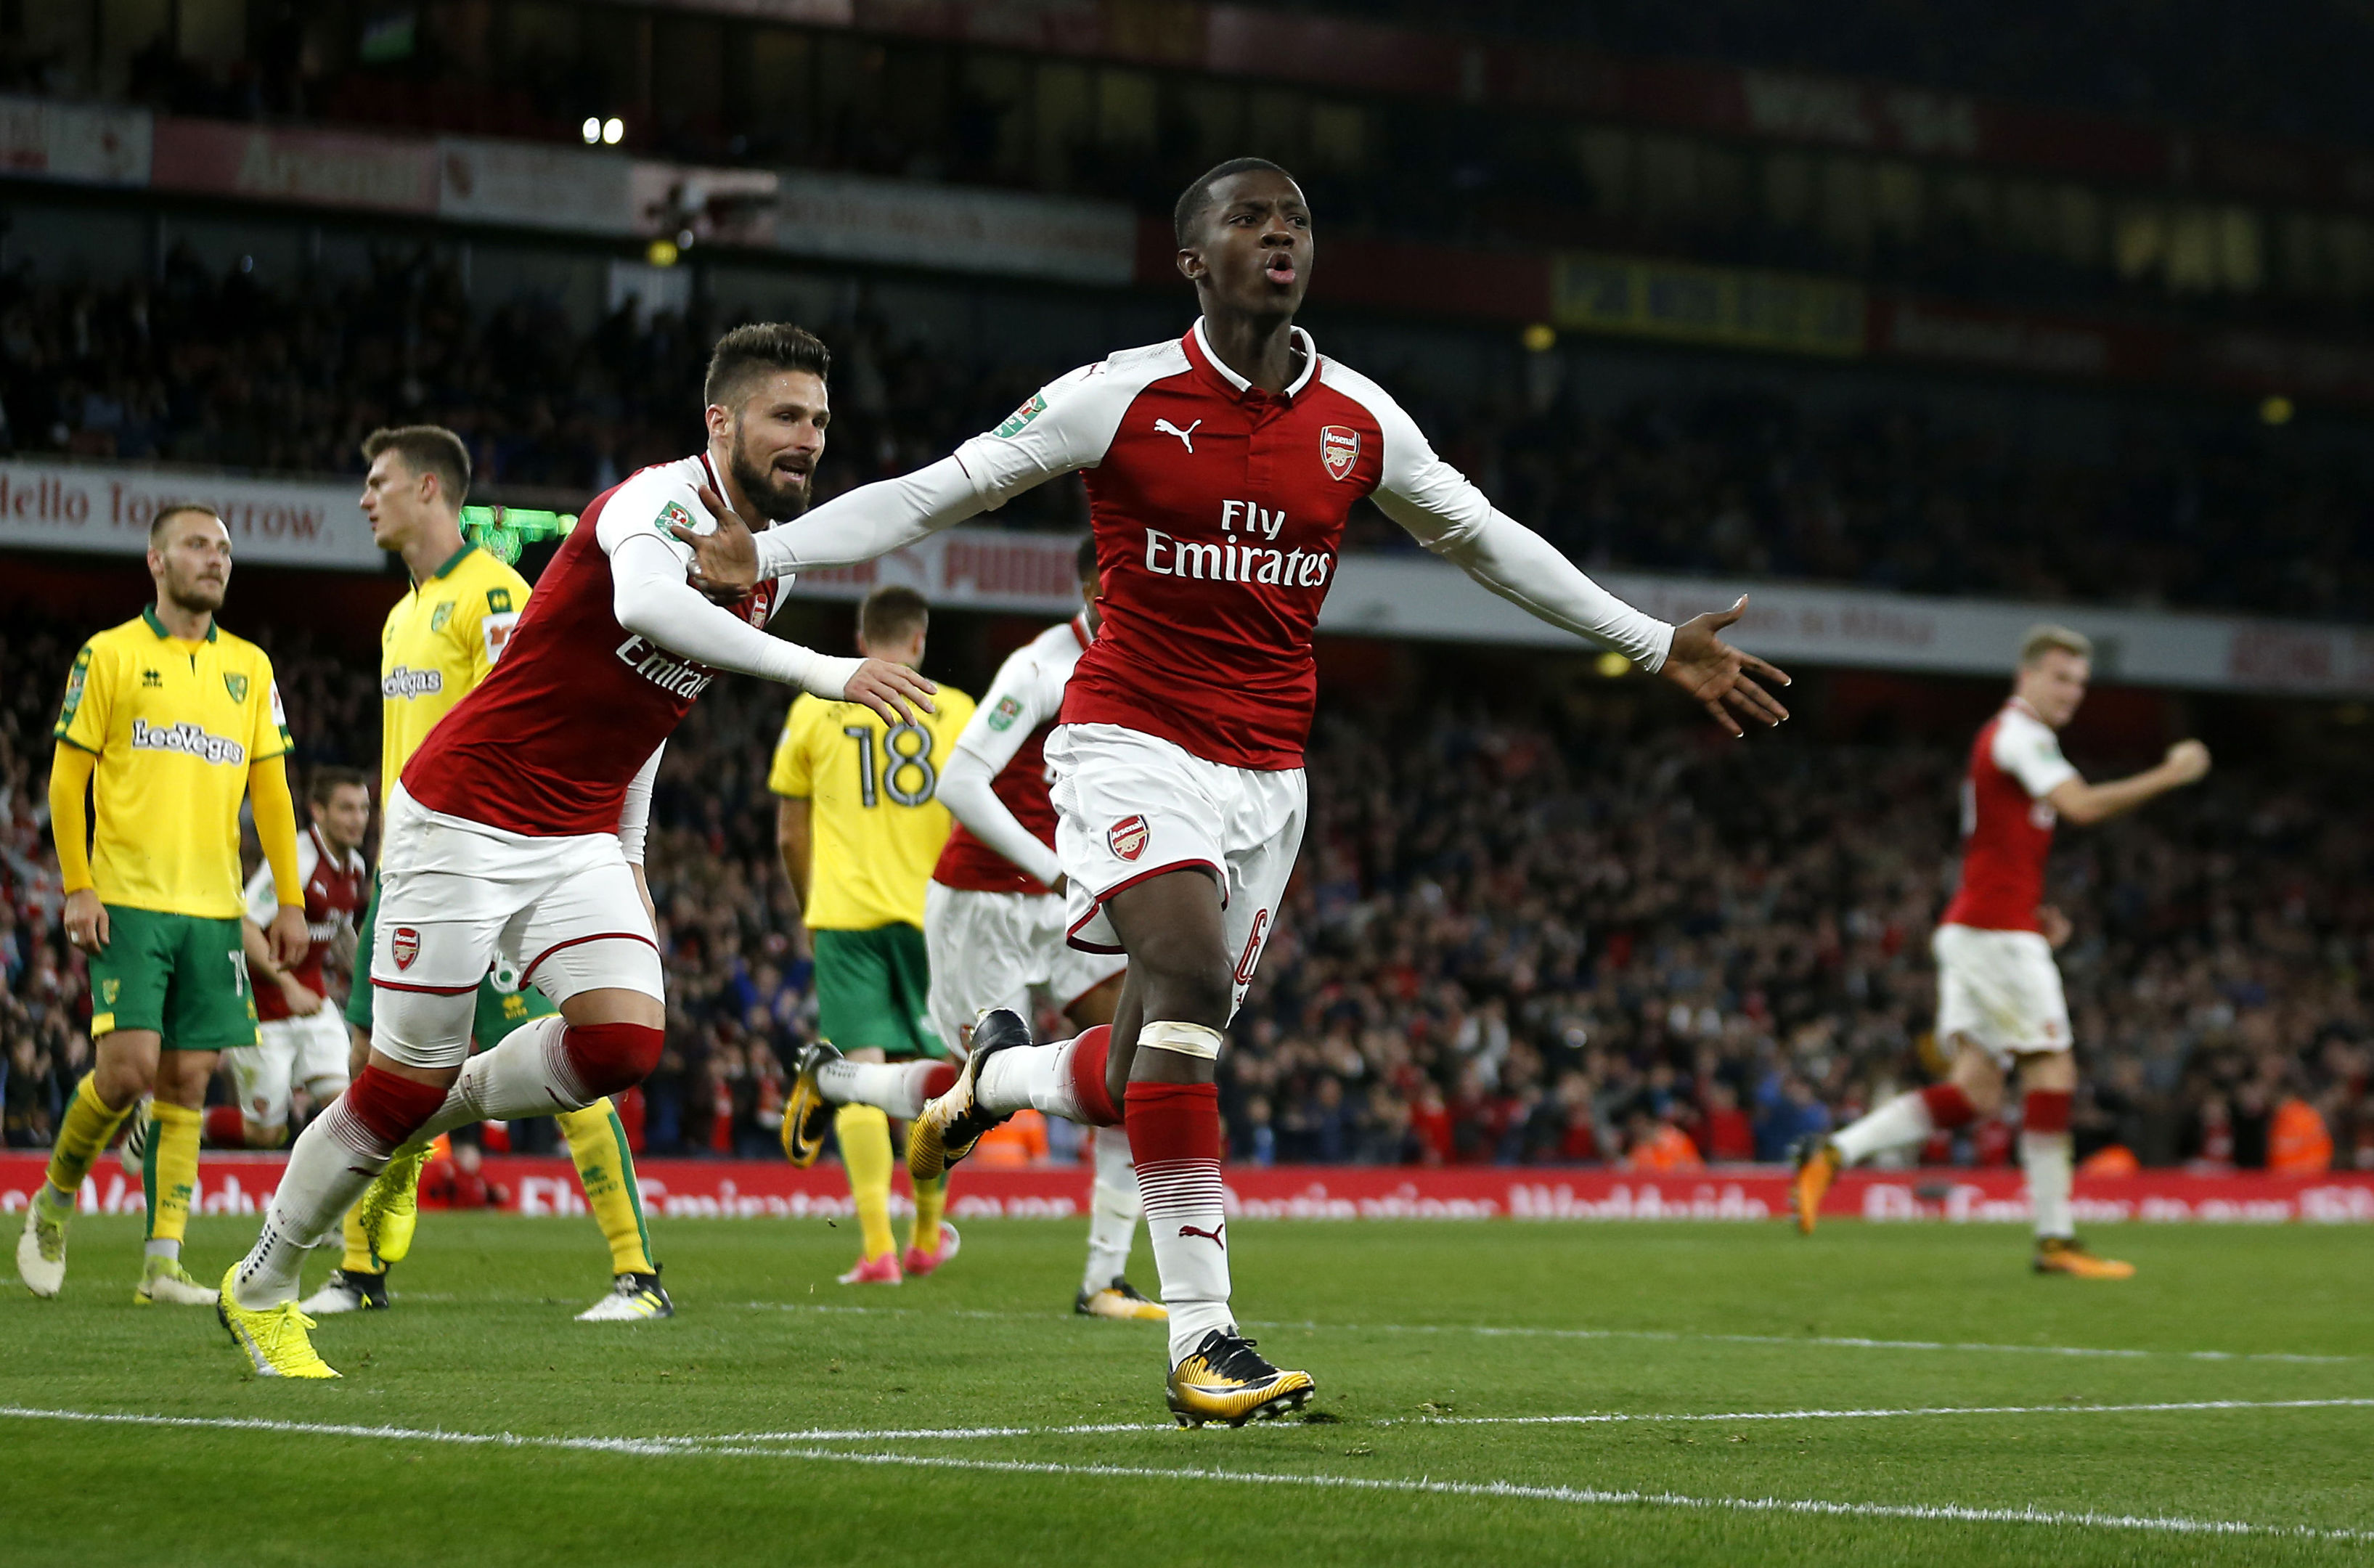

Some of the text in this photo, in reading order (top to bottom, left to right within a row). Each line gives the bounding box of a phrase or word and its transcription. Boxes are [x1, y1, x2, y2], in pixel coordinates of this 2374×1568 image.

[1326, 433, 1355, 446] Arsenal
[1222, 499, 1286, 540] Fly
[1145, 527, 1329, 587] Emirates
[616, 633, 713, 700] Emirat
[132, 719, 245, 767] LeoVegas
[844, 721, 937, 805] 18
[1111, 820, 1142, 840] Arsenal
